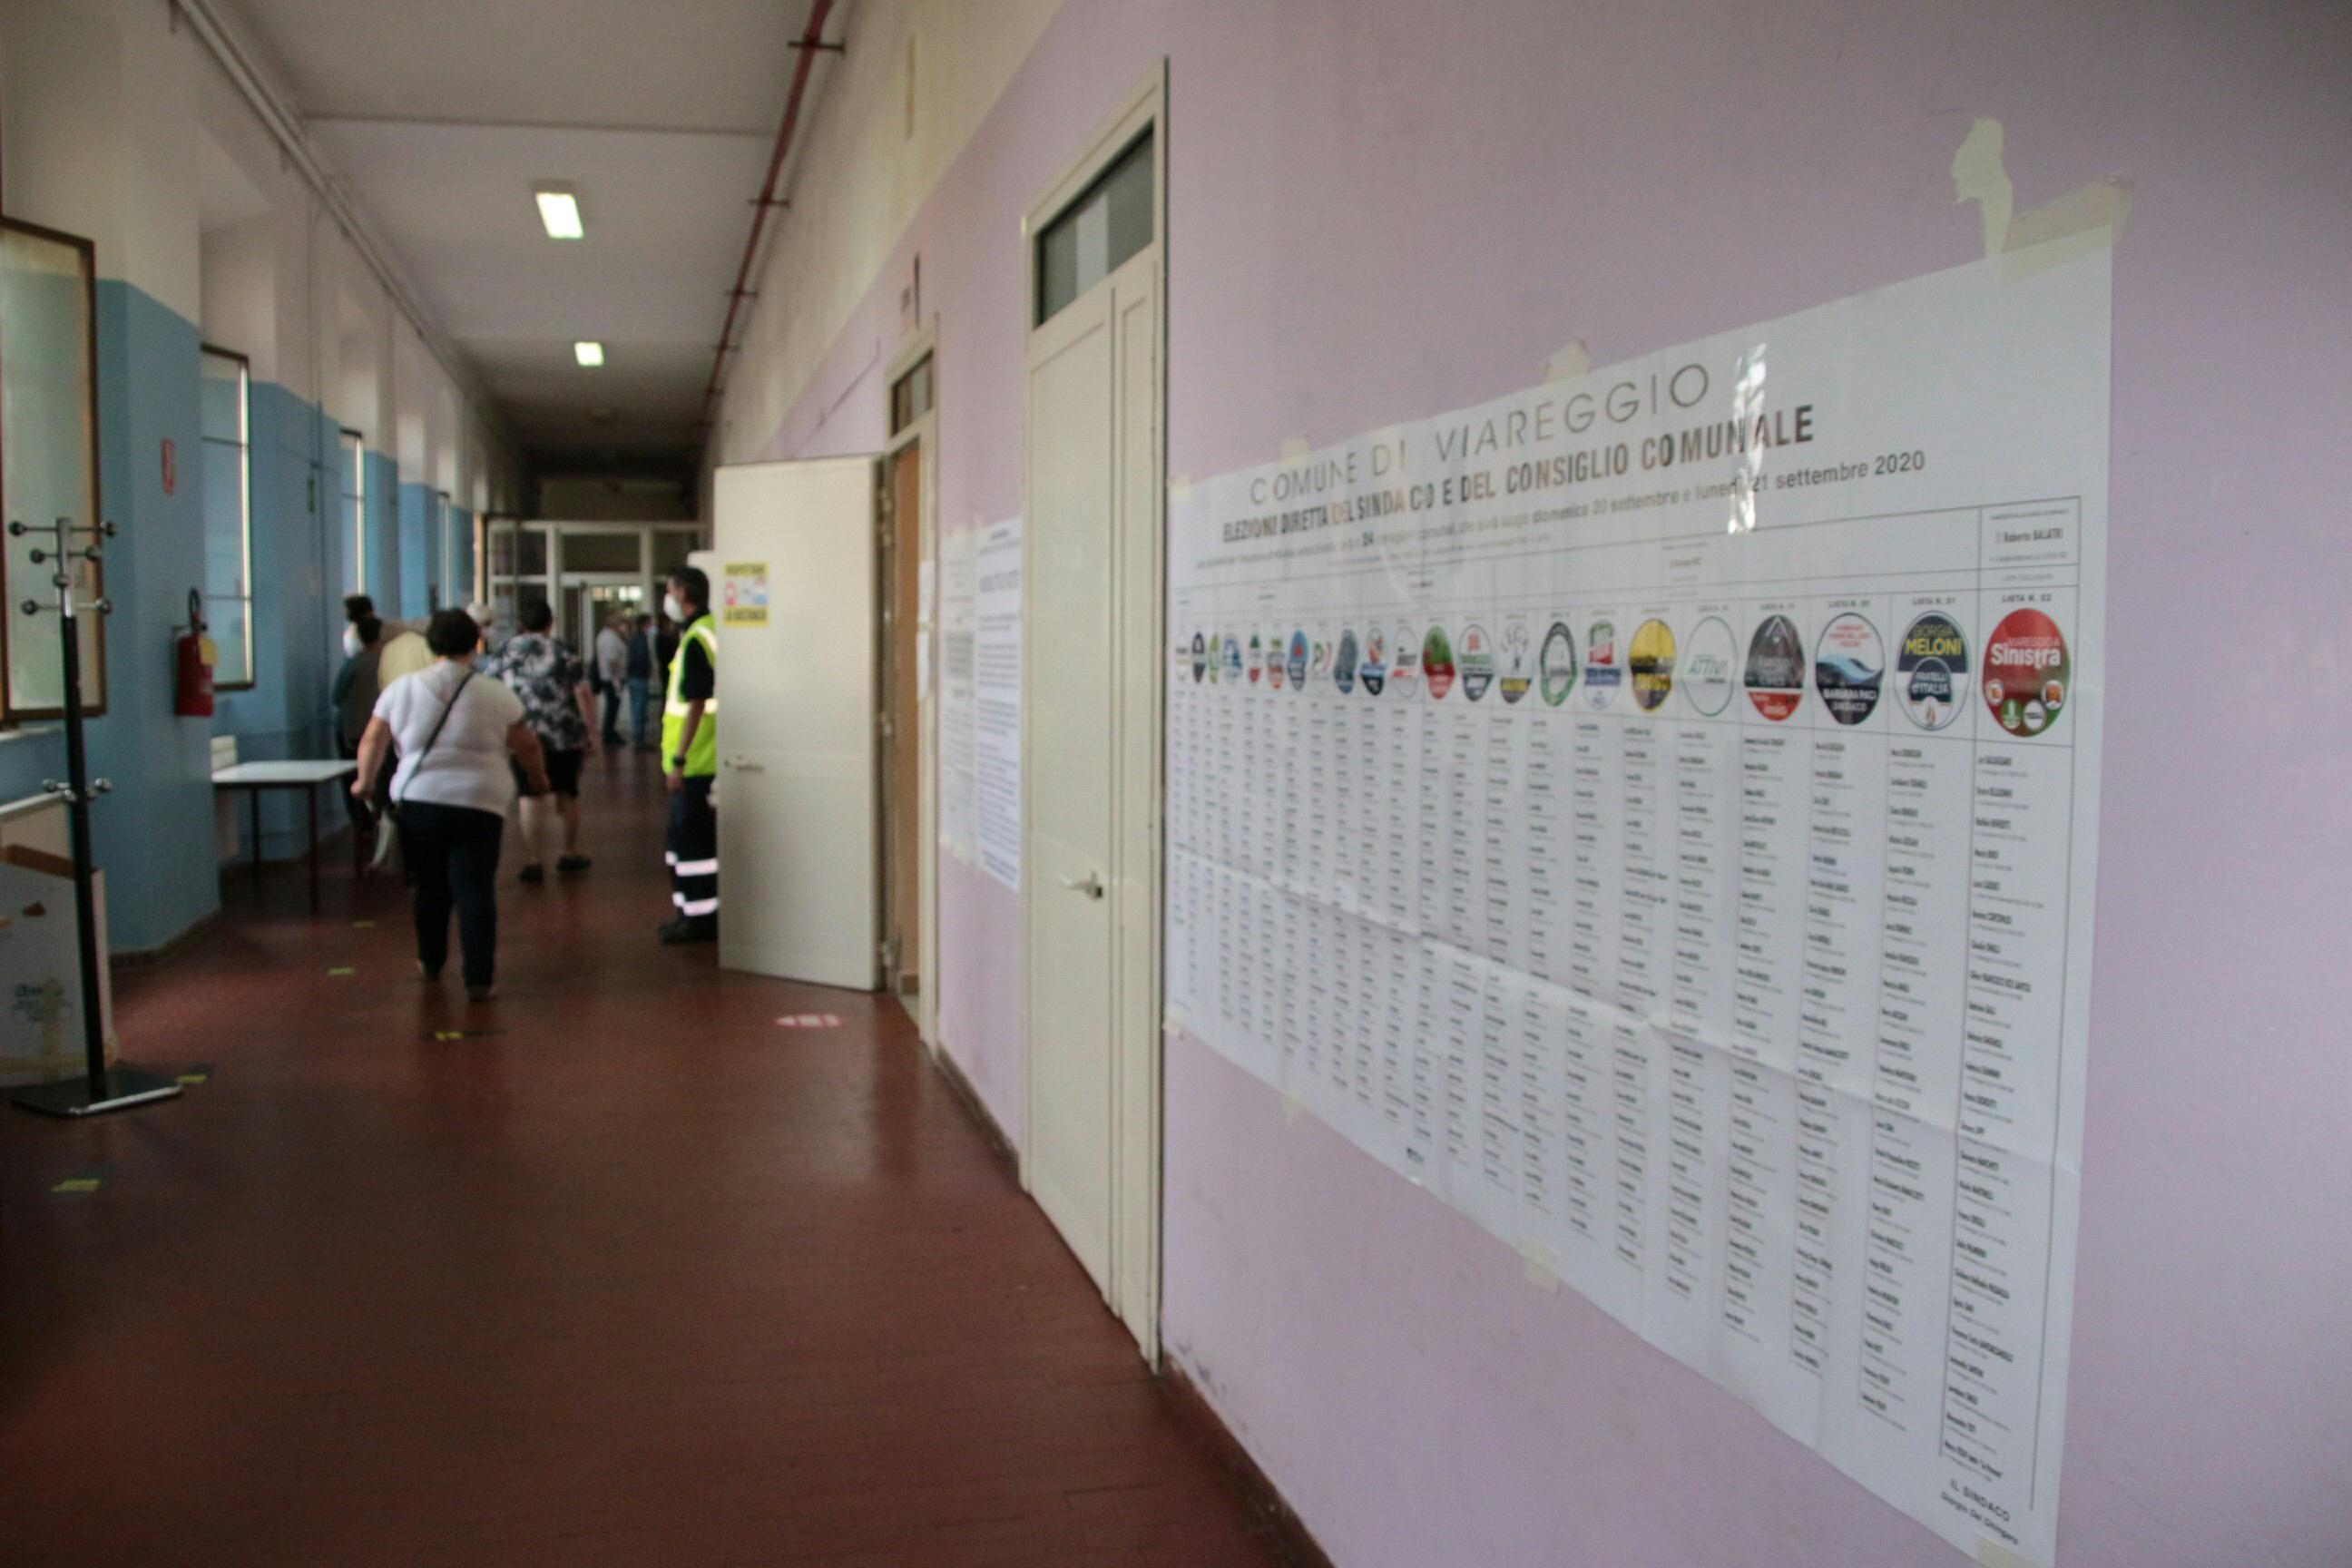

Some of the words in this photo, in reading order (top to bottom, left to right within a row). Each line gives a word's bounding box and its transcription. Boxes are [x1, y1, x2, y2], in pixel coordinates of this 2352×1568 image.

[1250, 452, 1357, 505] COMUNE
[1373, 440, 1406, 476] DI
[1436, 363, 1710, 463] VIAREGGIO
[1281, 505, 1328, 534] DIRETTA
[1357, 484, 1435, 520] SINDACO
[1443, 478, 1452, 505] E
[1461, 470, 1495, 503] DEL
[1506, 443, 1629, 494] CONSIGLIO
[1642, 405, 1814, 471] COMUNALE
[1533, 505, 1589, 524] domenica
[1612, 490, 1679, 512] settembre
[1753, 473, 1769, 494] 21
[1776, 461, 1868, 489] settembre
[1875, 450, 1926, 475] 2020
[1905, 638, 1962, 655] MELONI
[1990, 642, 2061, 670] Sinistra
[1964, 1486, 2010, 1522] SINDACO
